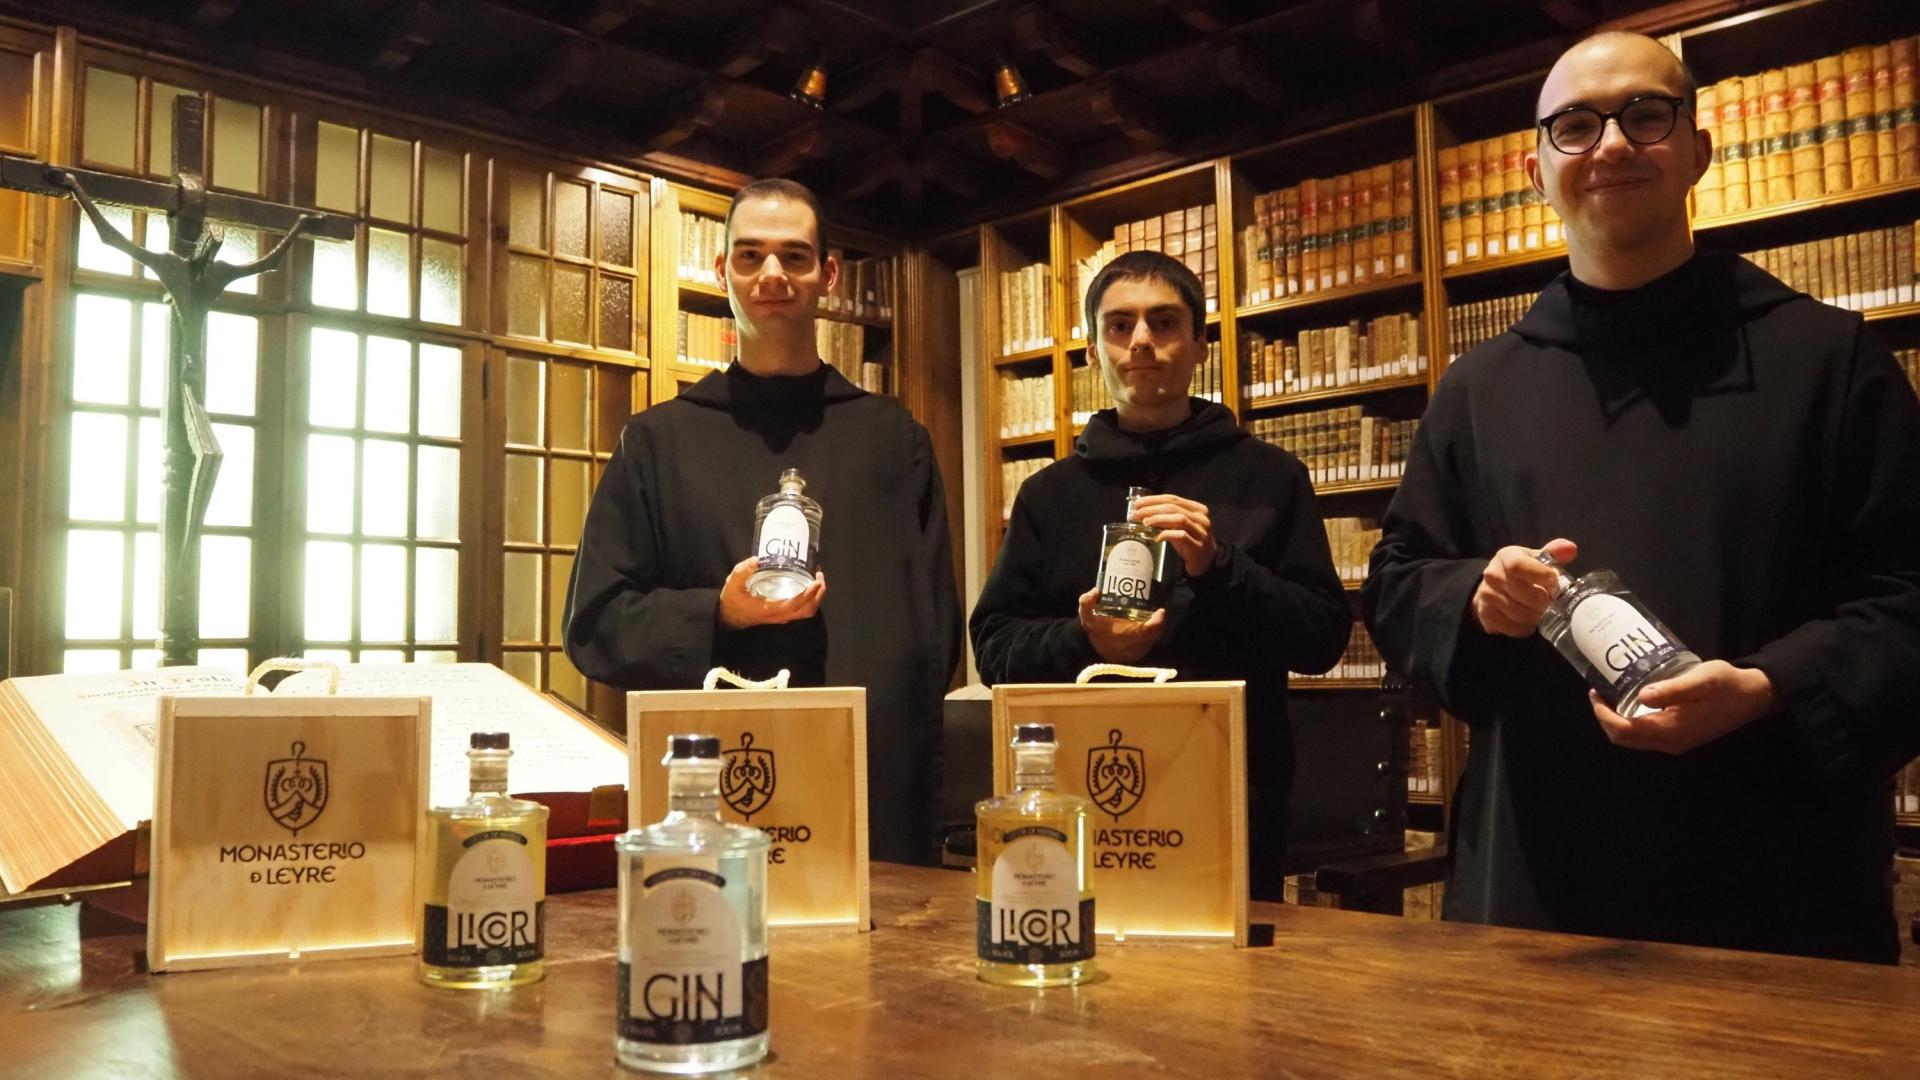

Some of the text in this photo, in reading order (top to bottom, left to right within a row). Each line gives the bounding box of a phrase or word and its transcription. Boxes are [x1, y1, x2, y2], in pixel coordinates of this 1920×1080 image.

[766, 538, 800, 560] GIN
[1107, 576, 1147, 600] LICOR
[1605, 627, 1658, 672] GIN
[1093, 829, 1184, 847] ASTERIO
[219, 842, 366, 863] MONASTERIO
[1093, 851, 1157, 869] LEYRE
[266, 866, 336, 885] LEYRE
[457, 911, 531, 948] LICOR
[1000, 909, 1074, 946] LICOR
[644, 973, 723, 1021] GIN
